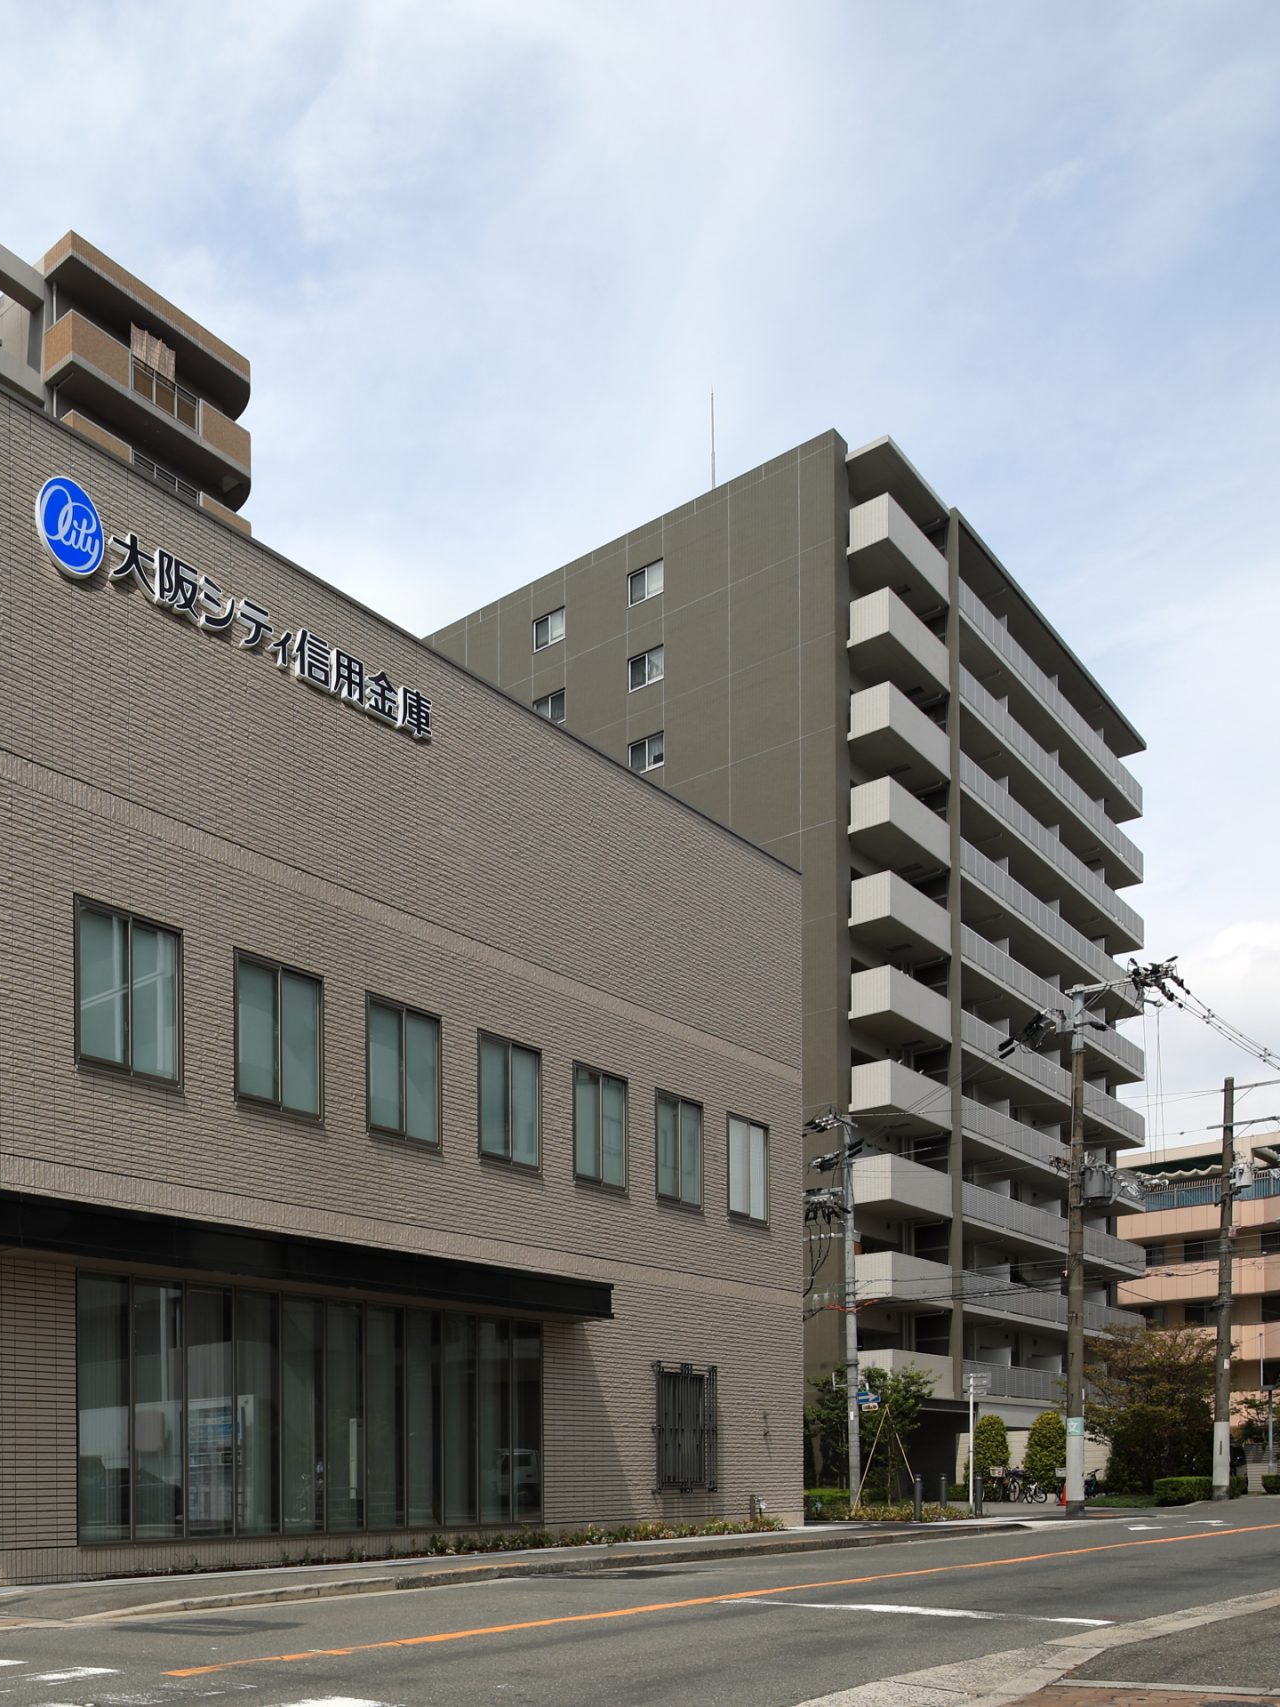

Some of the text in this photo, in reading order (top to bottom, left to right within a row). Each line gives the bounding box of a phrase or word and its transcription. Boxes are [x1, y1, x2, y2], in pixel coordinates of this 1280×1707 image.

[109, 533, 433, 740] 大阪シティ信用金庫
